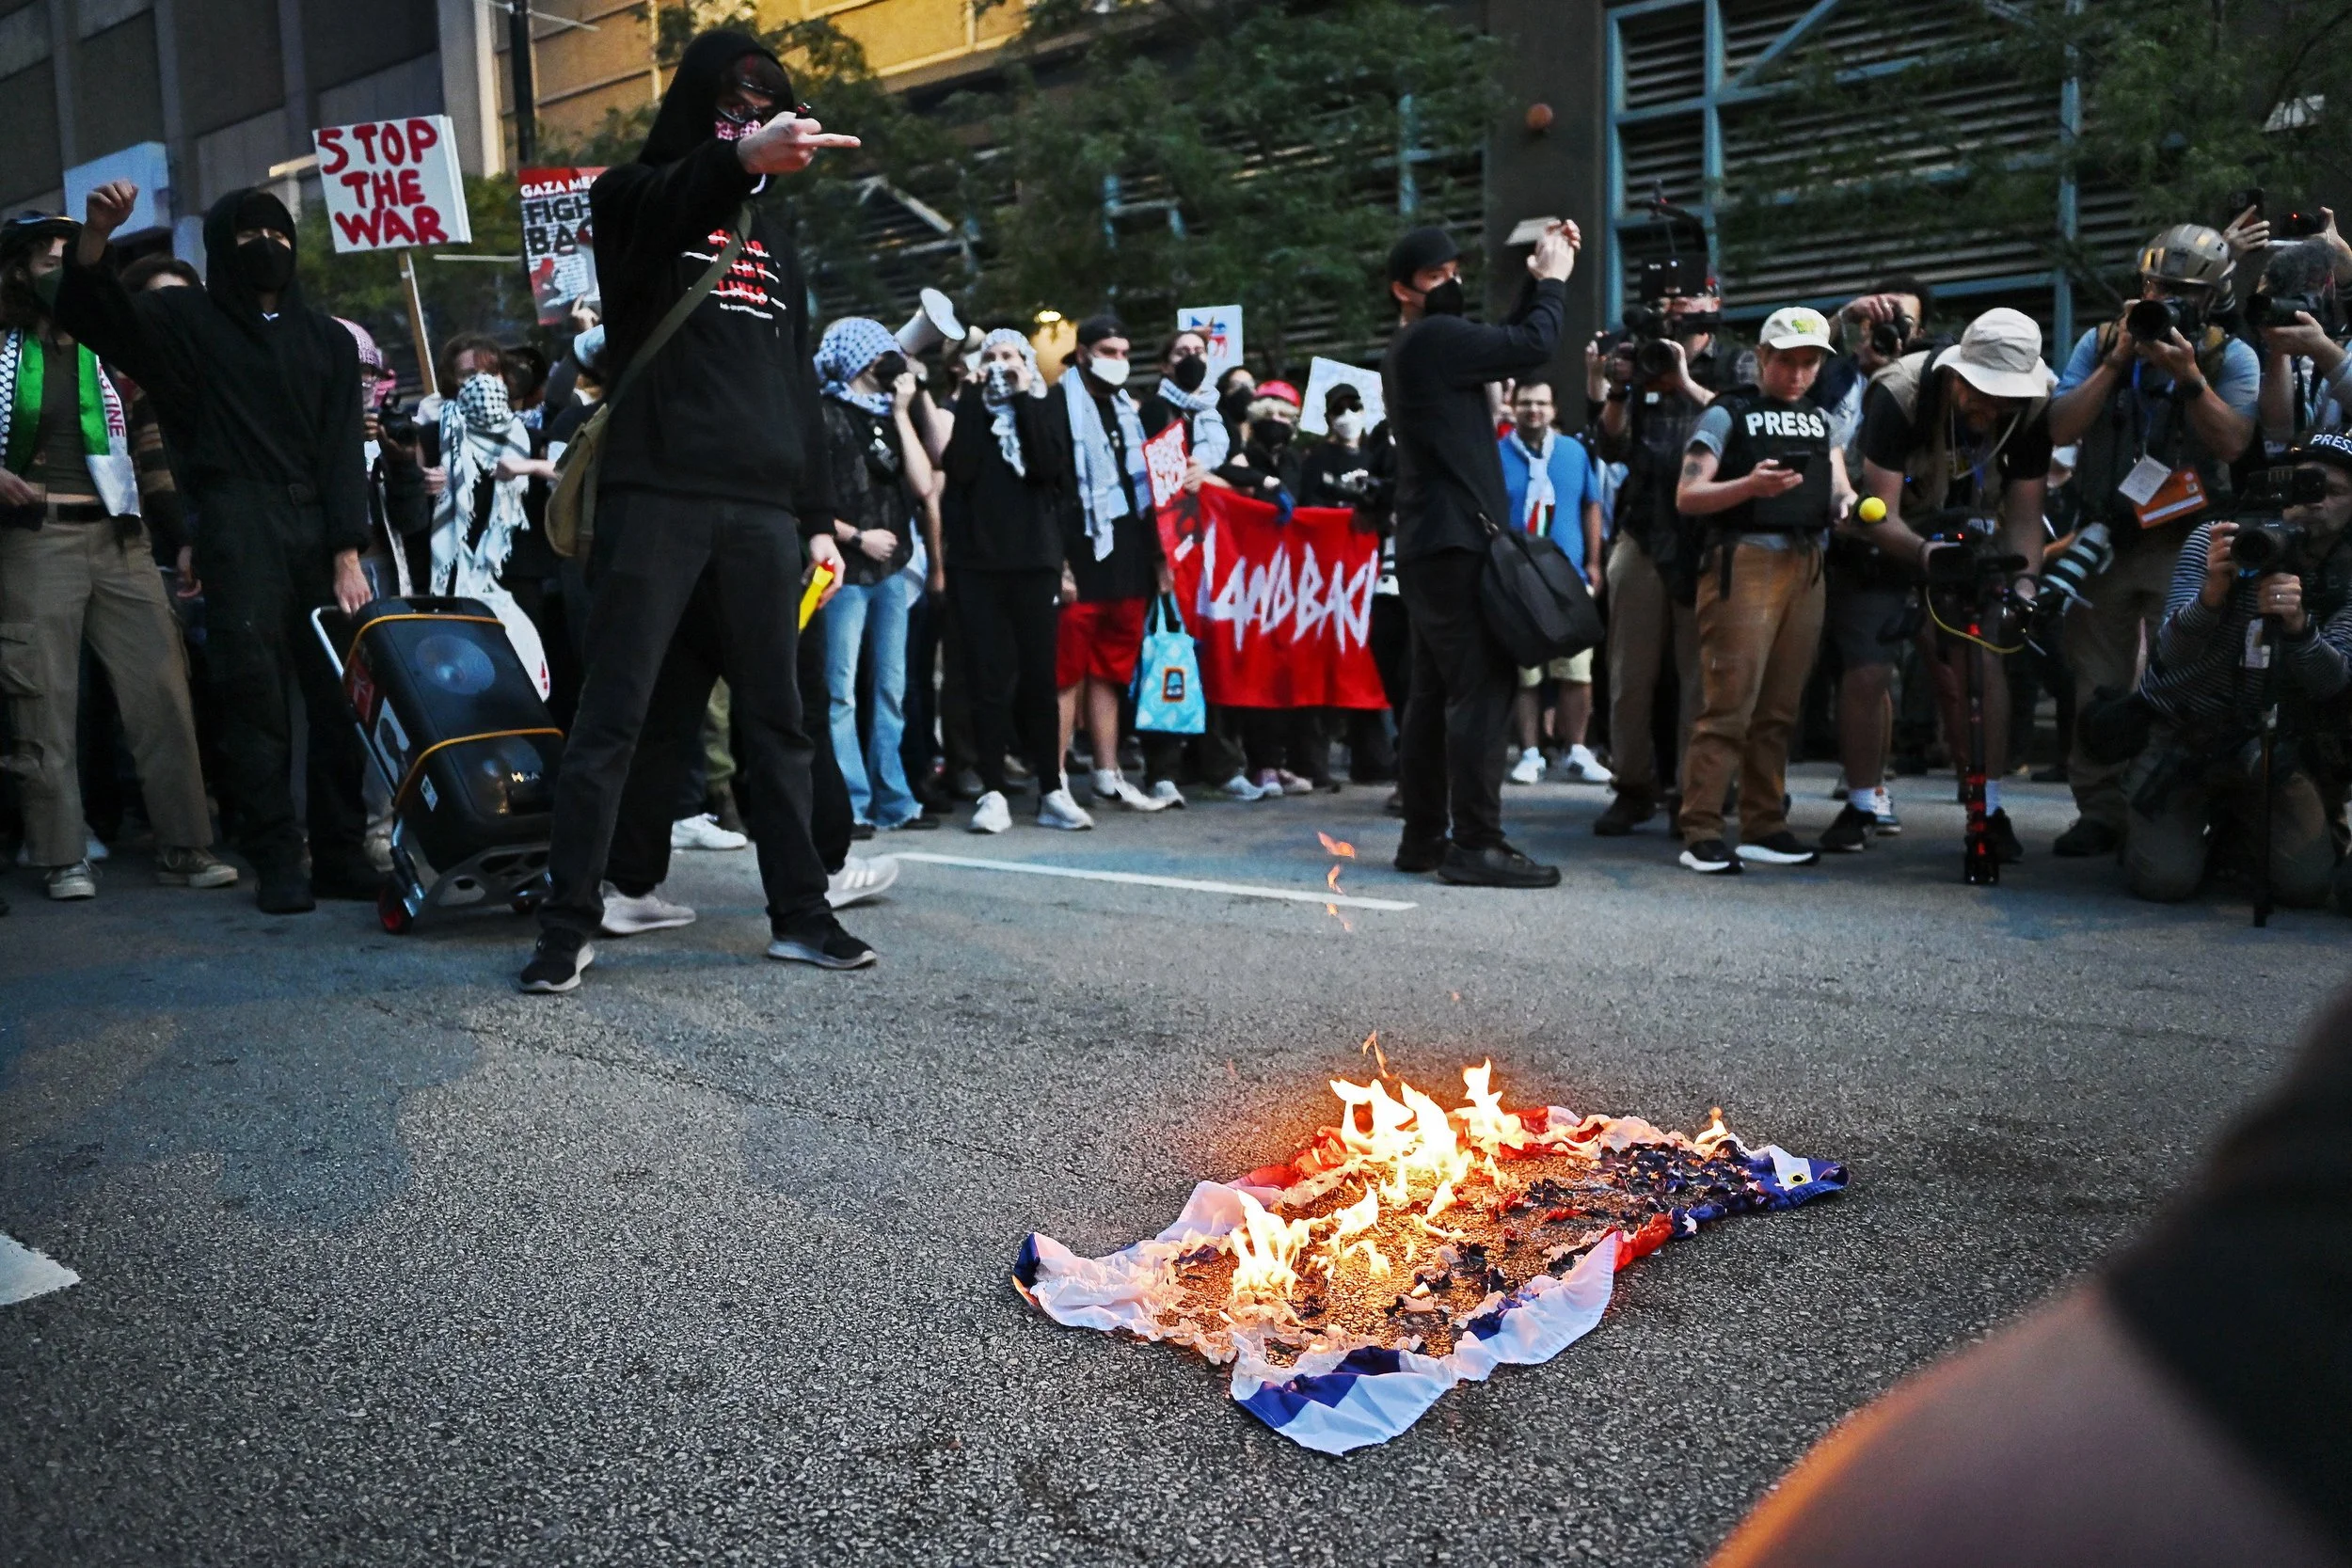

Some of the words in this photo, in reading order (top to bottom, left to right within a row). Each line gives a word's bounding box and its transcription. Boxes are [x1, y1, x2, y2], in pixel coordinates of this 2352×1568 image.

[318, 118, 438, 174] STOP
[341, 168, 425, 210] THE
[519, 180, 567, 198] GAZA
[334, 205, 449, 247] WAR
[1745, 410, 1825, 438] PRESS
